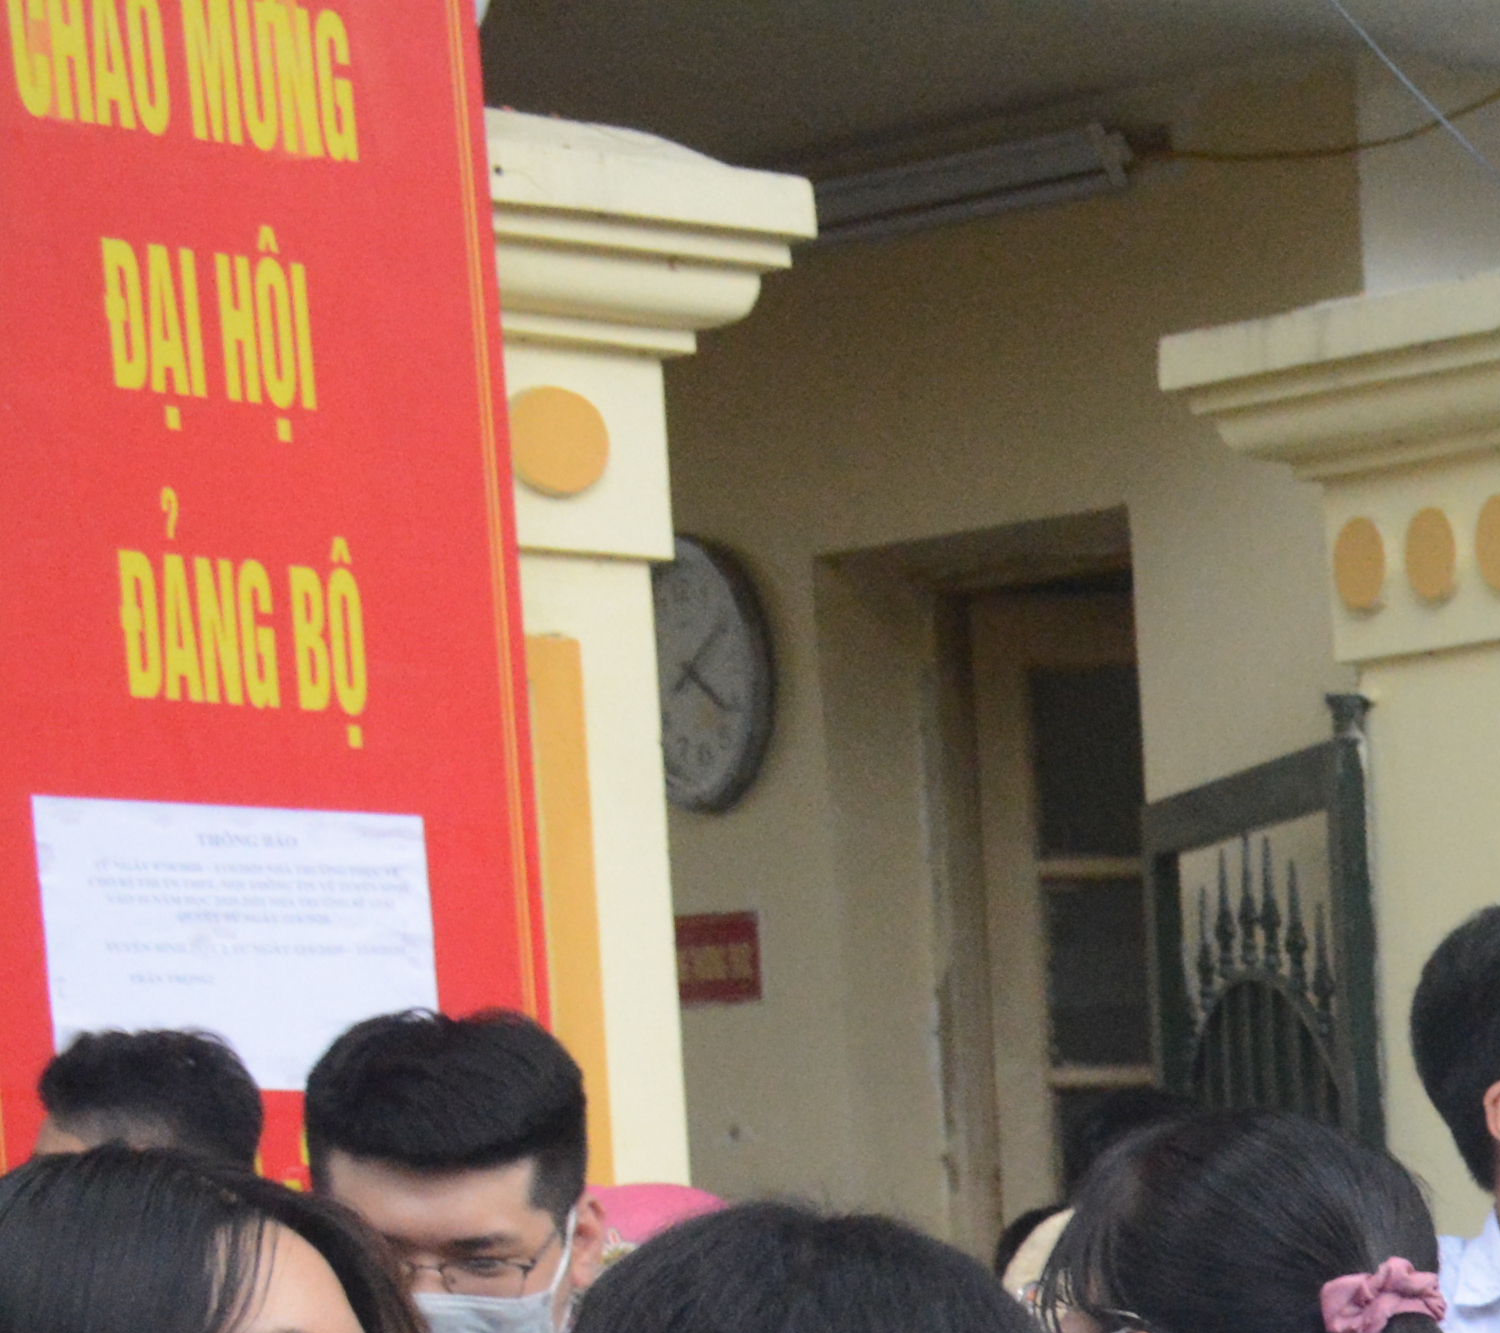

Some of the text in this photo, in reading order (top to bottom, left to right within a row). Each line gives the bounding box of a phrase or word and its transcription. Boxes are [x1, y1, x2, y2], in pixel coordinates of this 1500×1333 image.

[101, 225, 317, 443] ĐẠI HỘI
[117, 486, 367, 749] ĐẢNG BỘ
